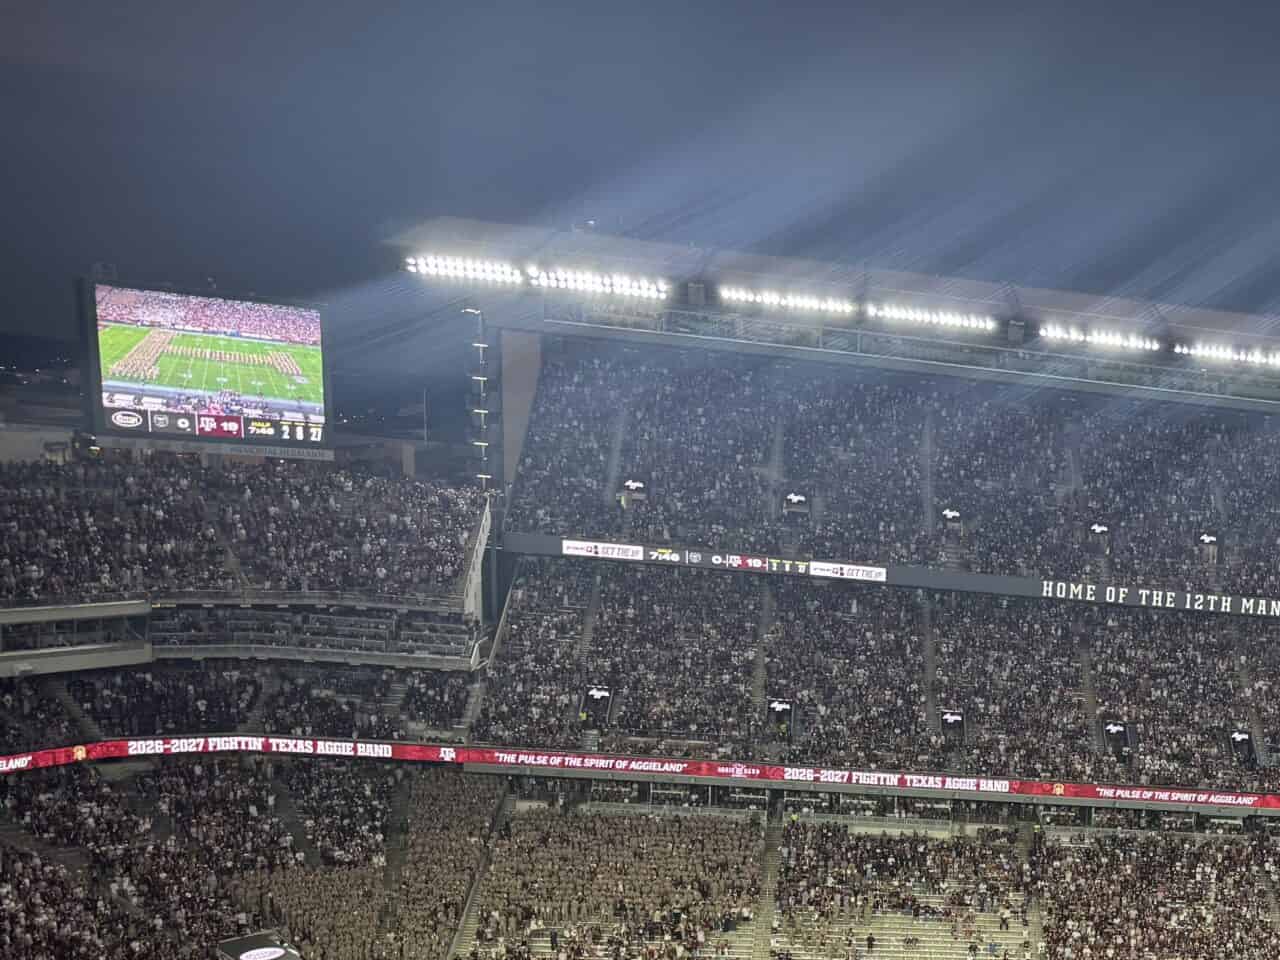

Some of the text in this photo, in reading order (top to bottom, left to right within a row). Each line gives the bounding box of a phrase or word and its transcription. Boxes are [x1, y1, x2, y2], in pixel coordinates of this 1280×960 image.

[1042, 580, 1096, 601] HOME
[1106, 586, 1128, 604] OF
[1139, 589, 1176, 608] THE
[1185, 593, 1232, 613] 12TH
[128, 736, 392, 757] 2026-2027 FIGHTIN' TEXAS AGGIE BAND
[518, 754, 548, 765] PULSE
[550, 755, 563, 765] OF
[564, 756, 583, 767] THE
[584, 757, 615, 769] SPIRIT
[616, 759, 629, 769] OF
[784, 767, 850, 783] 2026-2027
[904, 774, 943, 789] TEXAS
[944, 776, 978, 791] AGGIE
[979, 778, 1009, 793] BAND
[1114, 788, 1140, 799] PULSE
[1141, 790, 1153, 800] OF
[1153, 791, 1170, 801] THE
[1170, 792, 1196, 803] SPIRIT
[1197, 793, 1208, 803] OF
